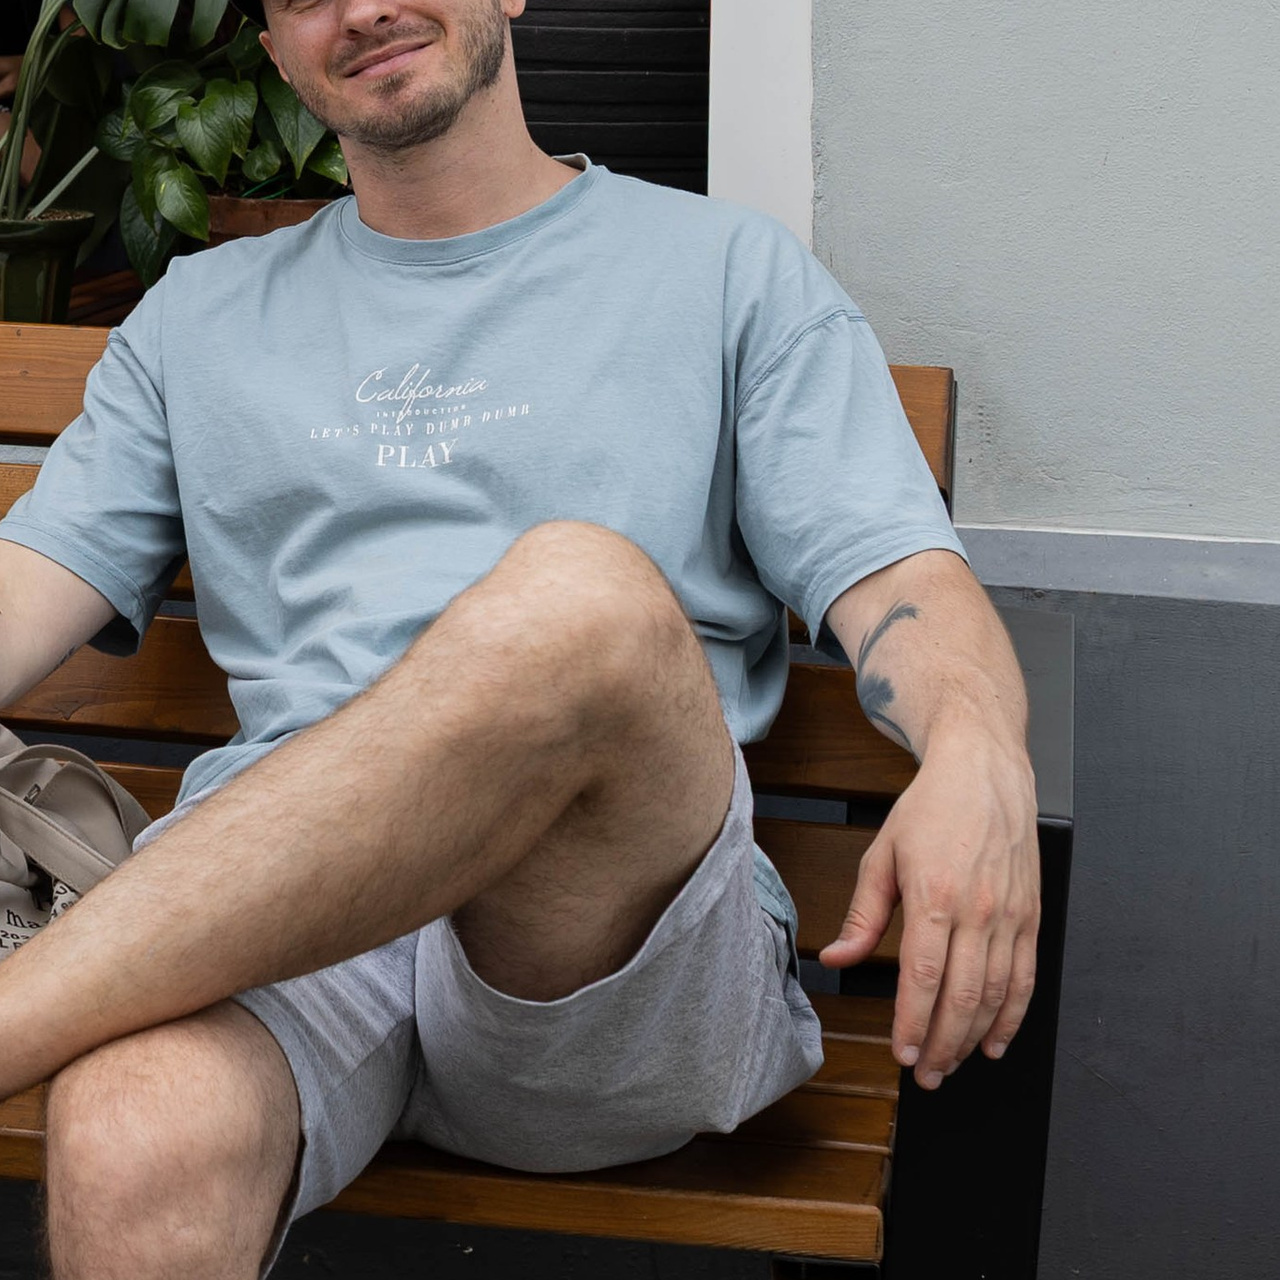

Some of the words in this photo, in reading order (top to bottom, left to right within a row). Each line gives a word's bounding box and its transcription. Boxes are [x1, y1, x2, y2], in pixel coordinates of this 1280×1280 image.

[356, 363, 488, 424] California
[310, 424, 360, 439] LET'S
[370, 423, 414, 436] PLAY
[376, 438, 458, 468] PLAY
